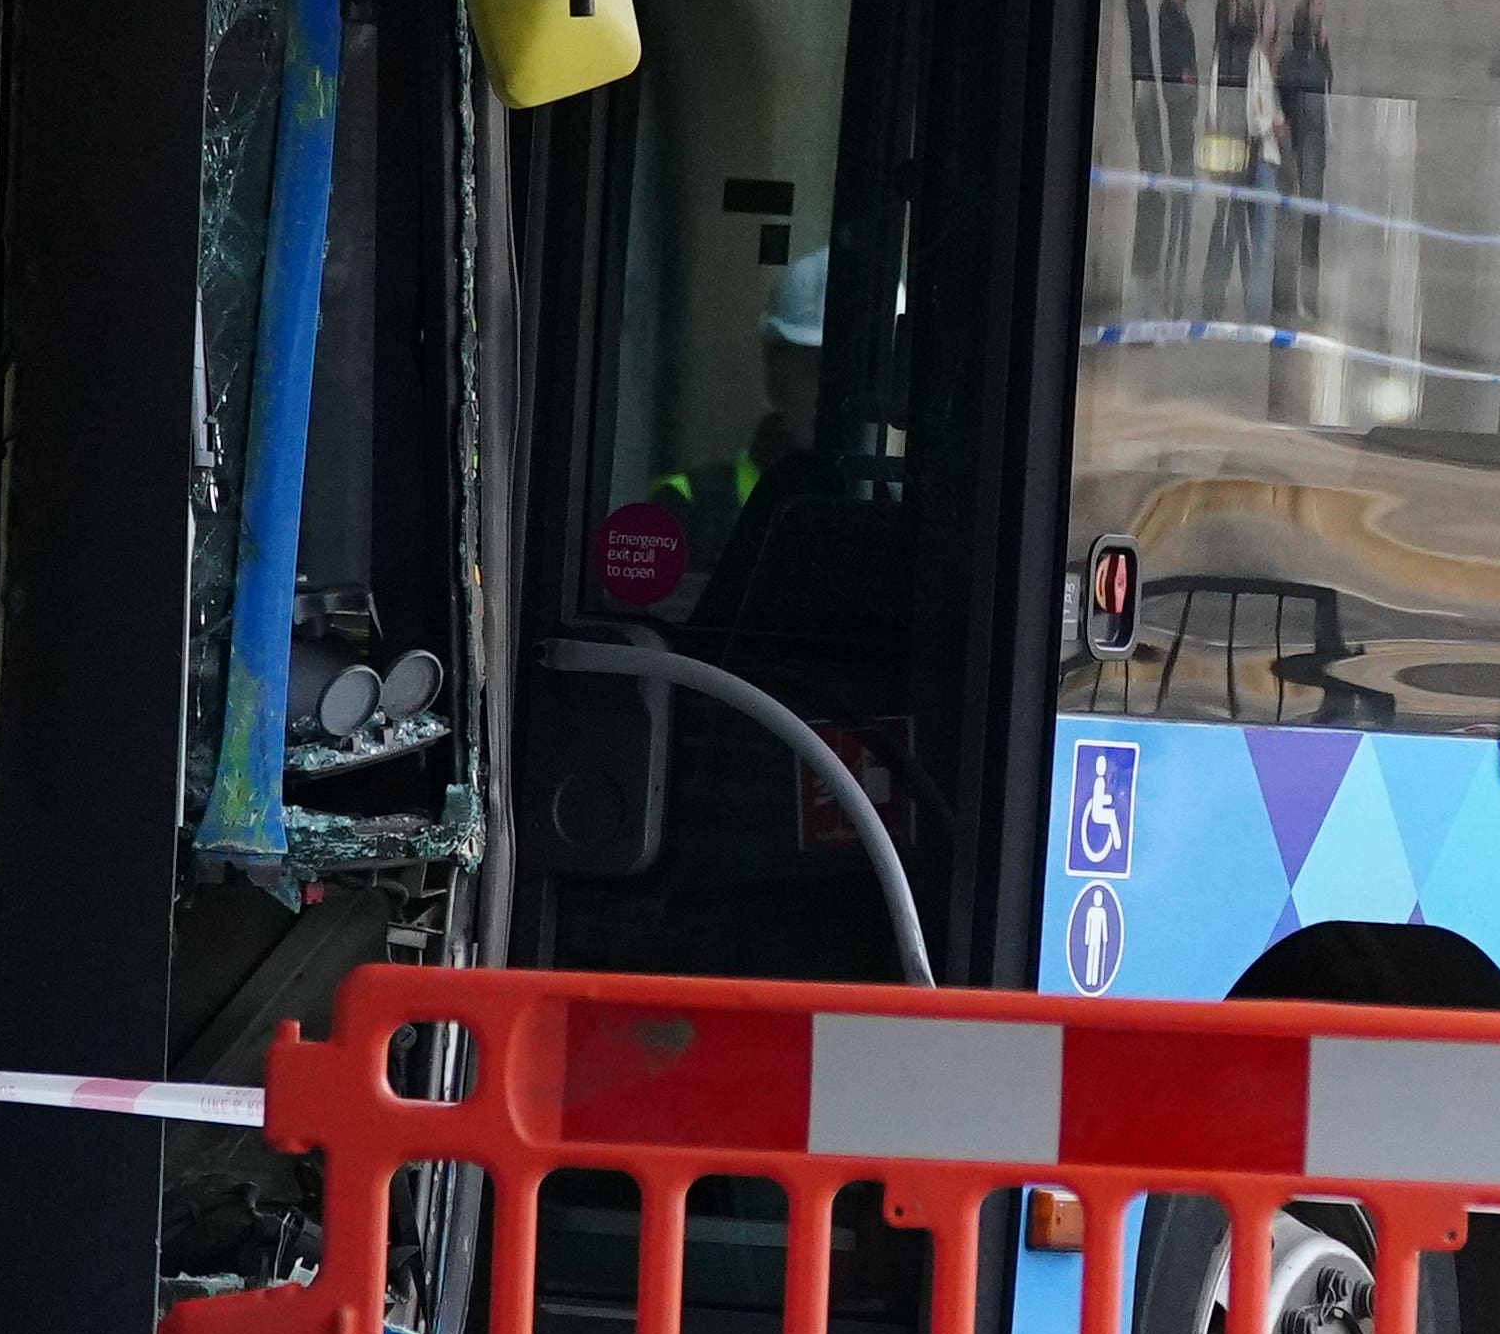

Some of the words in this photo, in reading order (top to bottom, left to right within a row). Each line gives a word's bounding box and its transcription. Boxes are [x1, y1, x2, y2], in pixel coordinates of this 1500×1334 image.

[608, 530, 678, 552] Emergency
[607, 547, 629, 562] exit
[633, 548, 656, 564] pull
[606, 564, 620, 578] to
[622, 567, 656, 581] open
